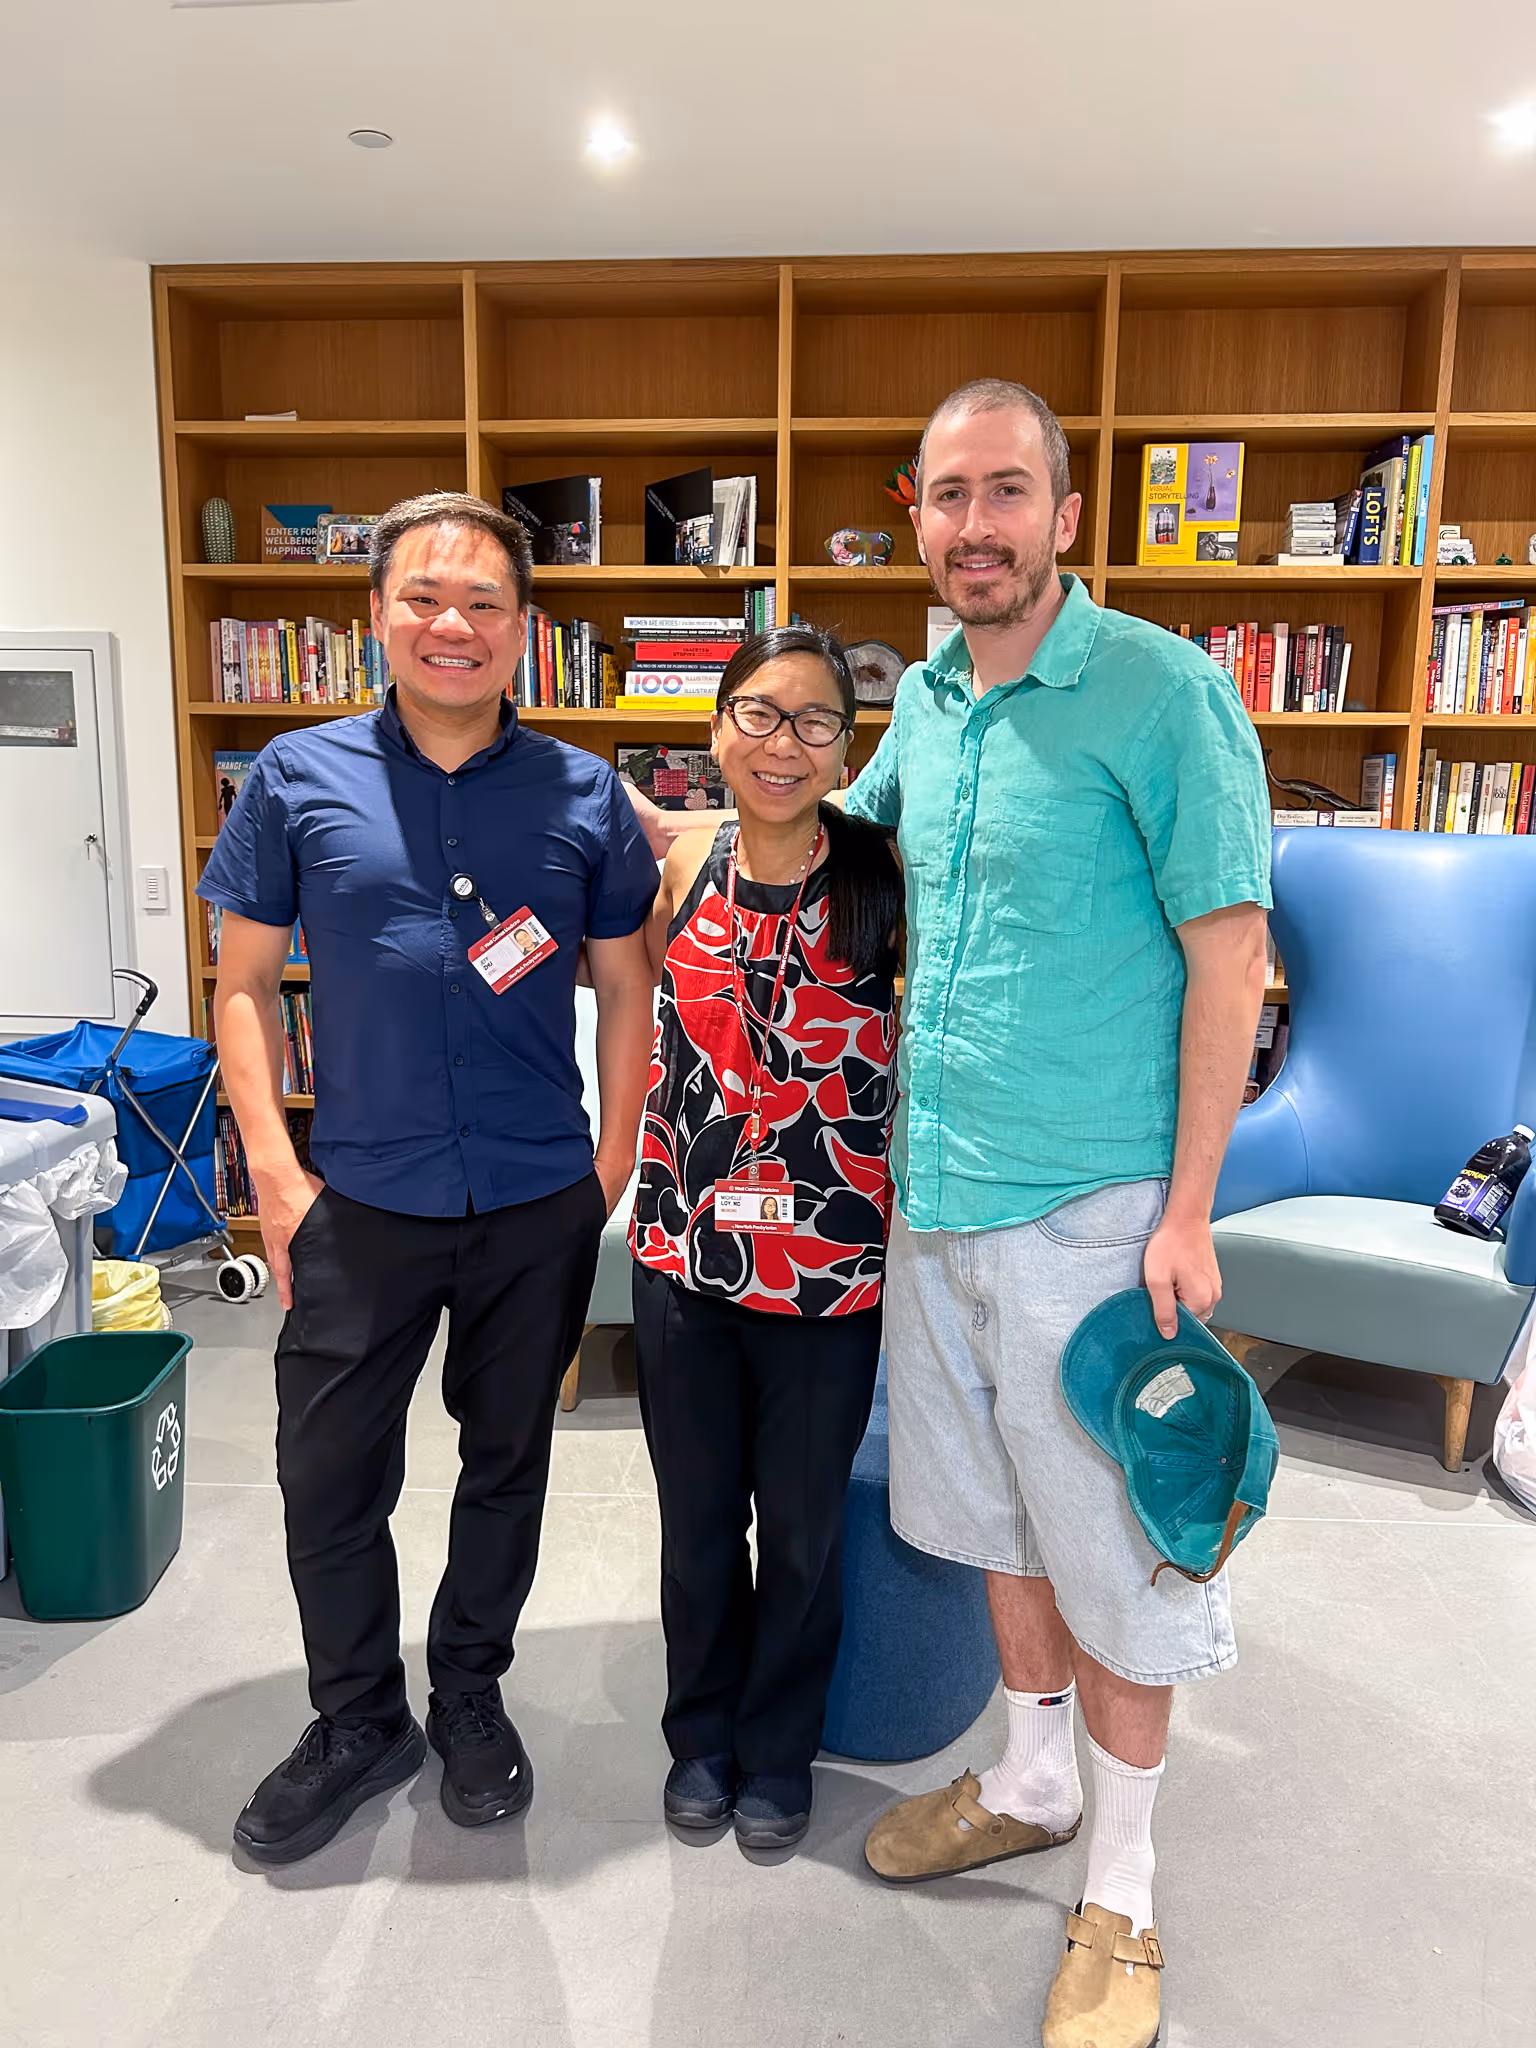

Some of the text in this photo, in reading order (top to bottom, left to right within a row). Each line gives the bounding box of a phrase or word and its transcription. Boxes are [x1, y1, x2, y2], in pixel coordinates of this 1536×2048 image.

[1363, 492, 1382, 545] LOFTS
[265, 528, 318, 536] CENTER FOR
[265, 537, 318, 545] WELLBEING
[265, 547, 317, 555] HAPPINESS
[634, 674, 683, 694] 100
[216, 762, 243, 770] CHANGE
